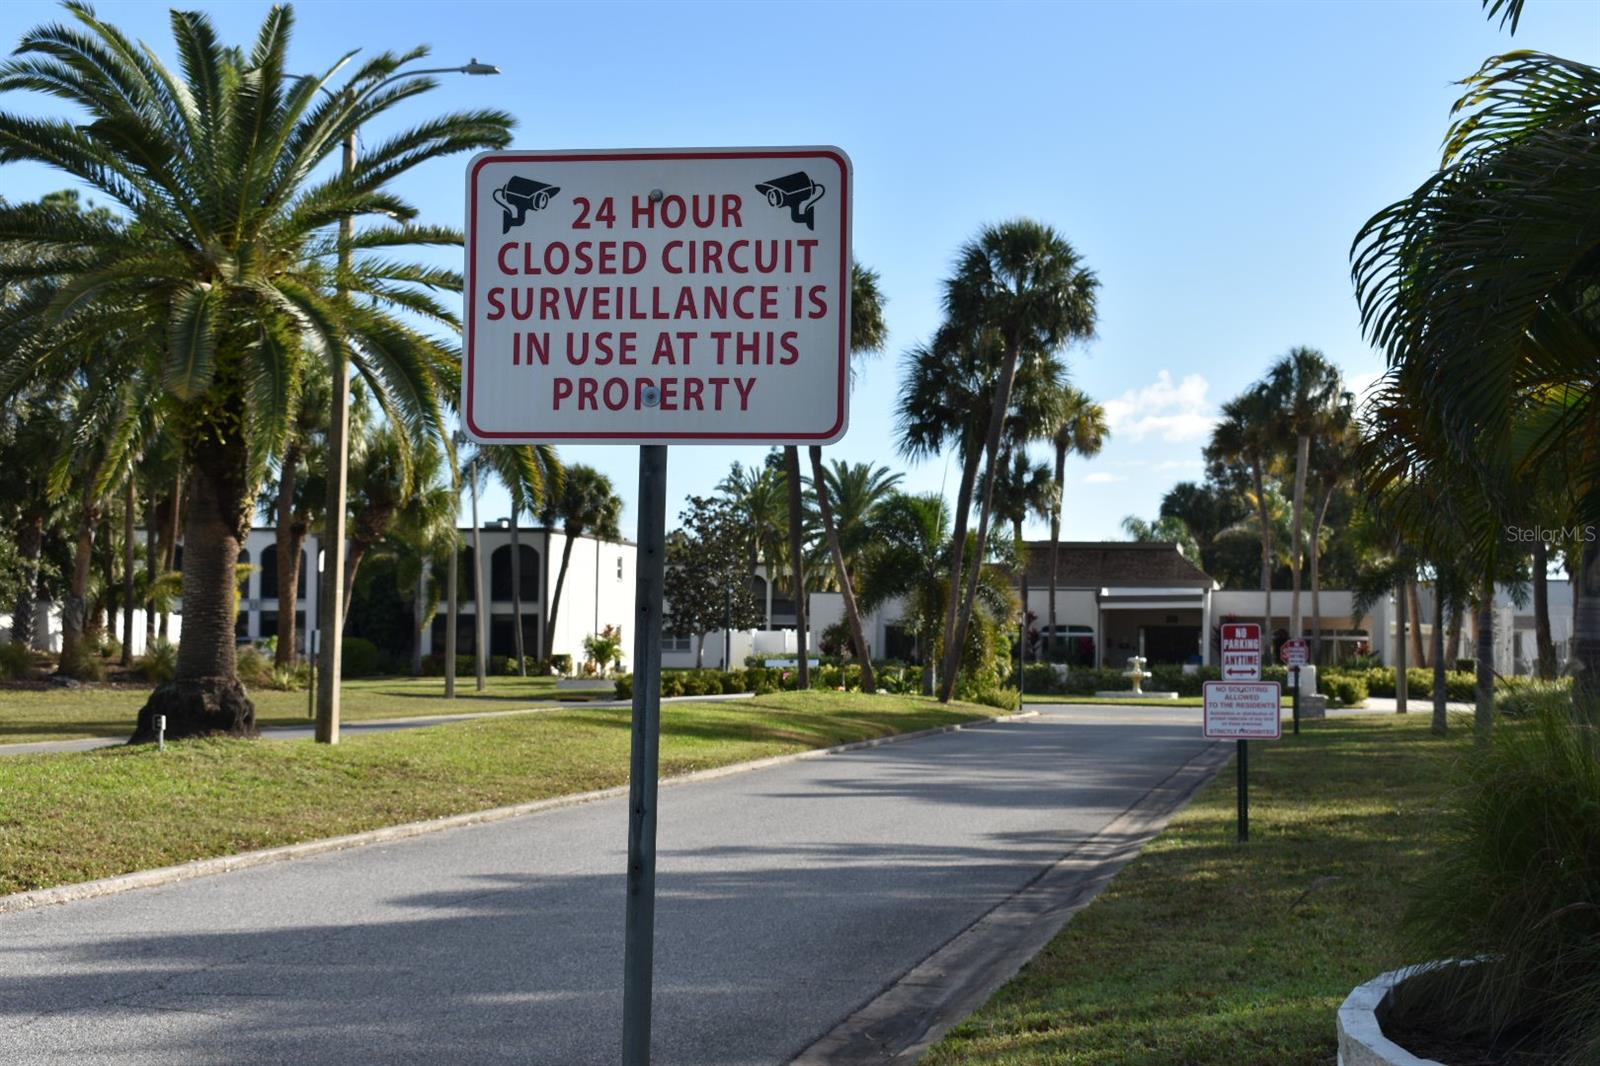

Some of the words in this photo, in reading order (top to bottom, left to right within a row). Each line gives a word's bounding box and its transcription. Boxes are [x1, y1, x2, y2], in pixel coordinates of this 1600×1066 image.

[572, 197, 616, 229] 24
[632, 194, 743, 229] HOUR
[498, 241, 647, 275] CLOSED
[661, 239, 818, 274] CIRCUIT
[486, 286, 778, 321] SURVEILLANCE
[794, 284, 828, 320] IS
[512, 332, 550, 365] IN
[566, 331, 638, 366] USE
[651, 332, 698, 365] AT
[711, 331, 800, 365] THIS
[552, 377, 757, 411] PROPERTY
[1223, 639, 1260, 650] PARKING
[1235, 627, 1247, 638] NO
[1224, 655, 1259, 665] ANYTIME
